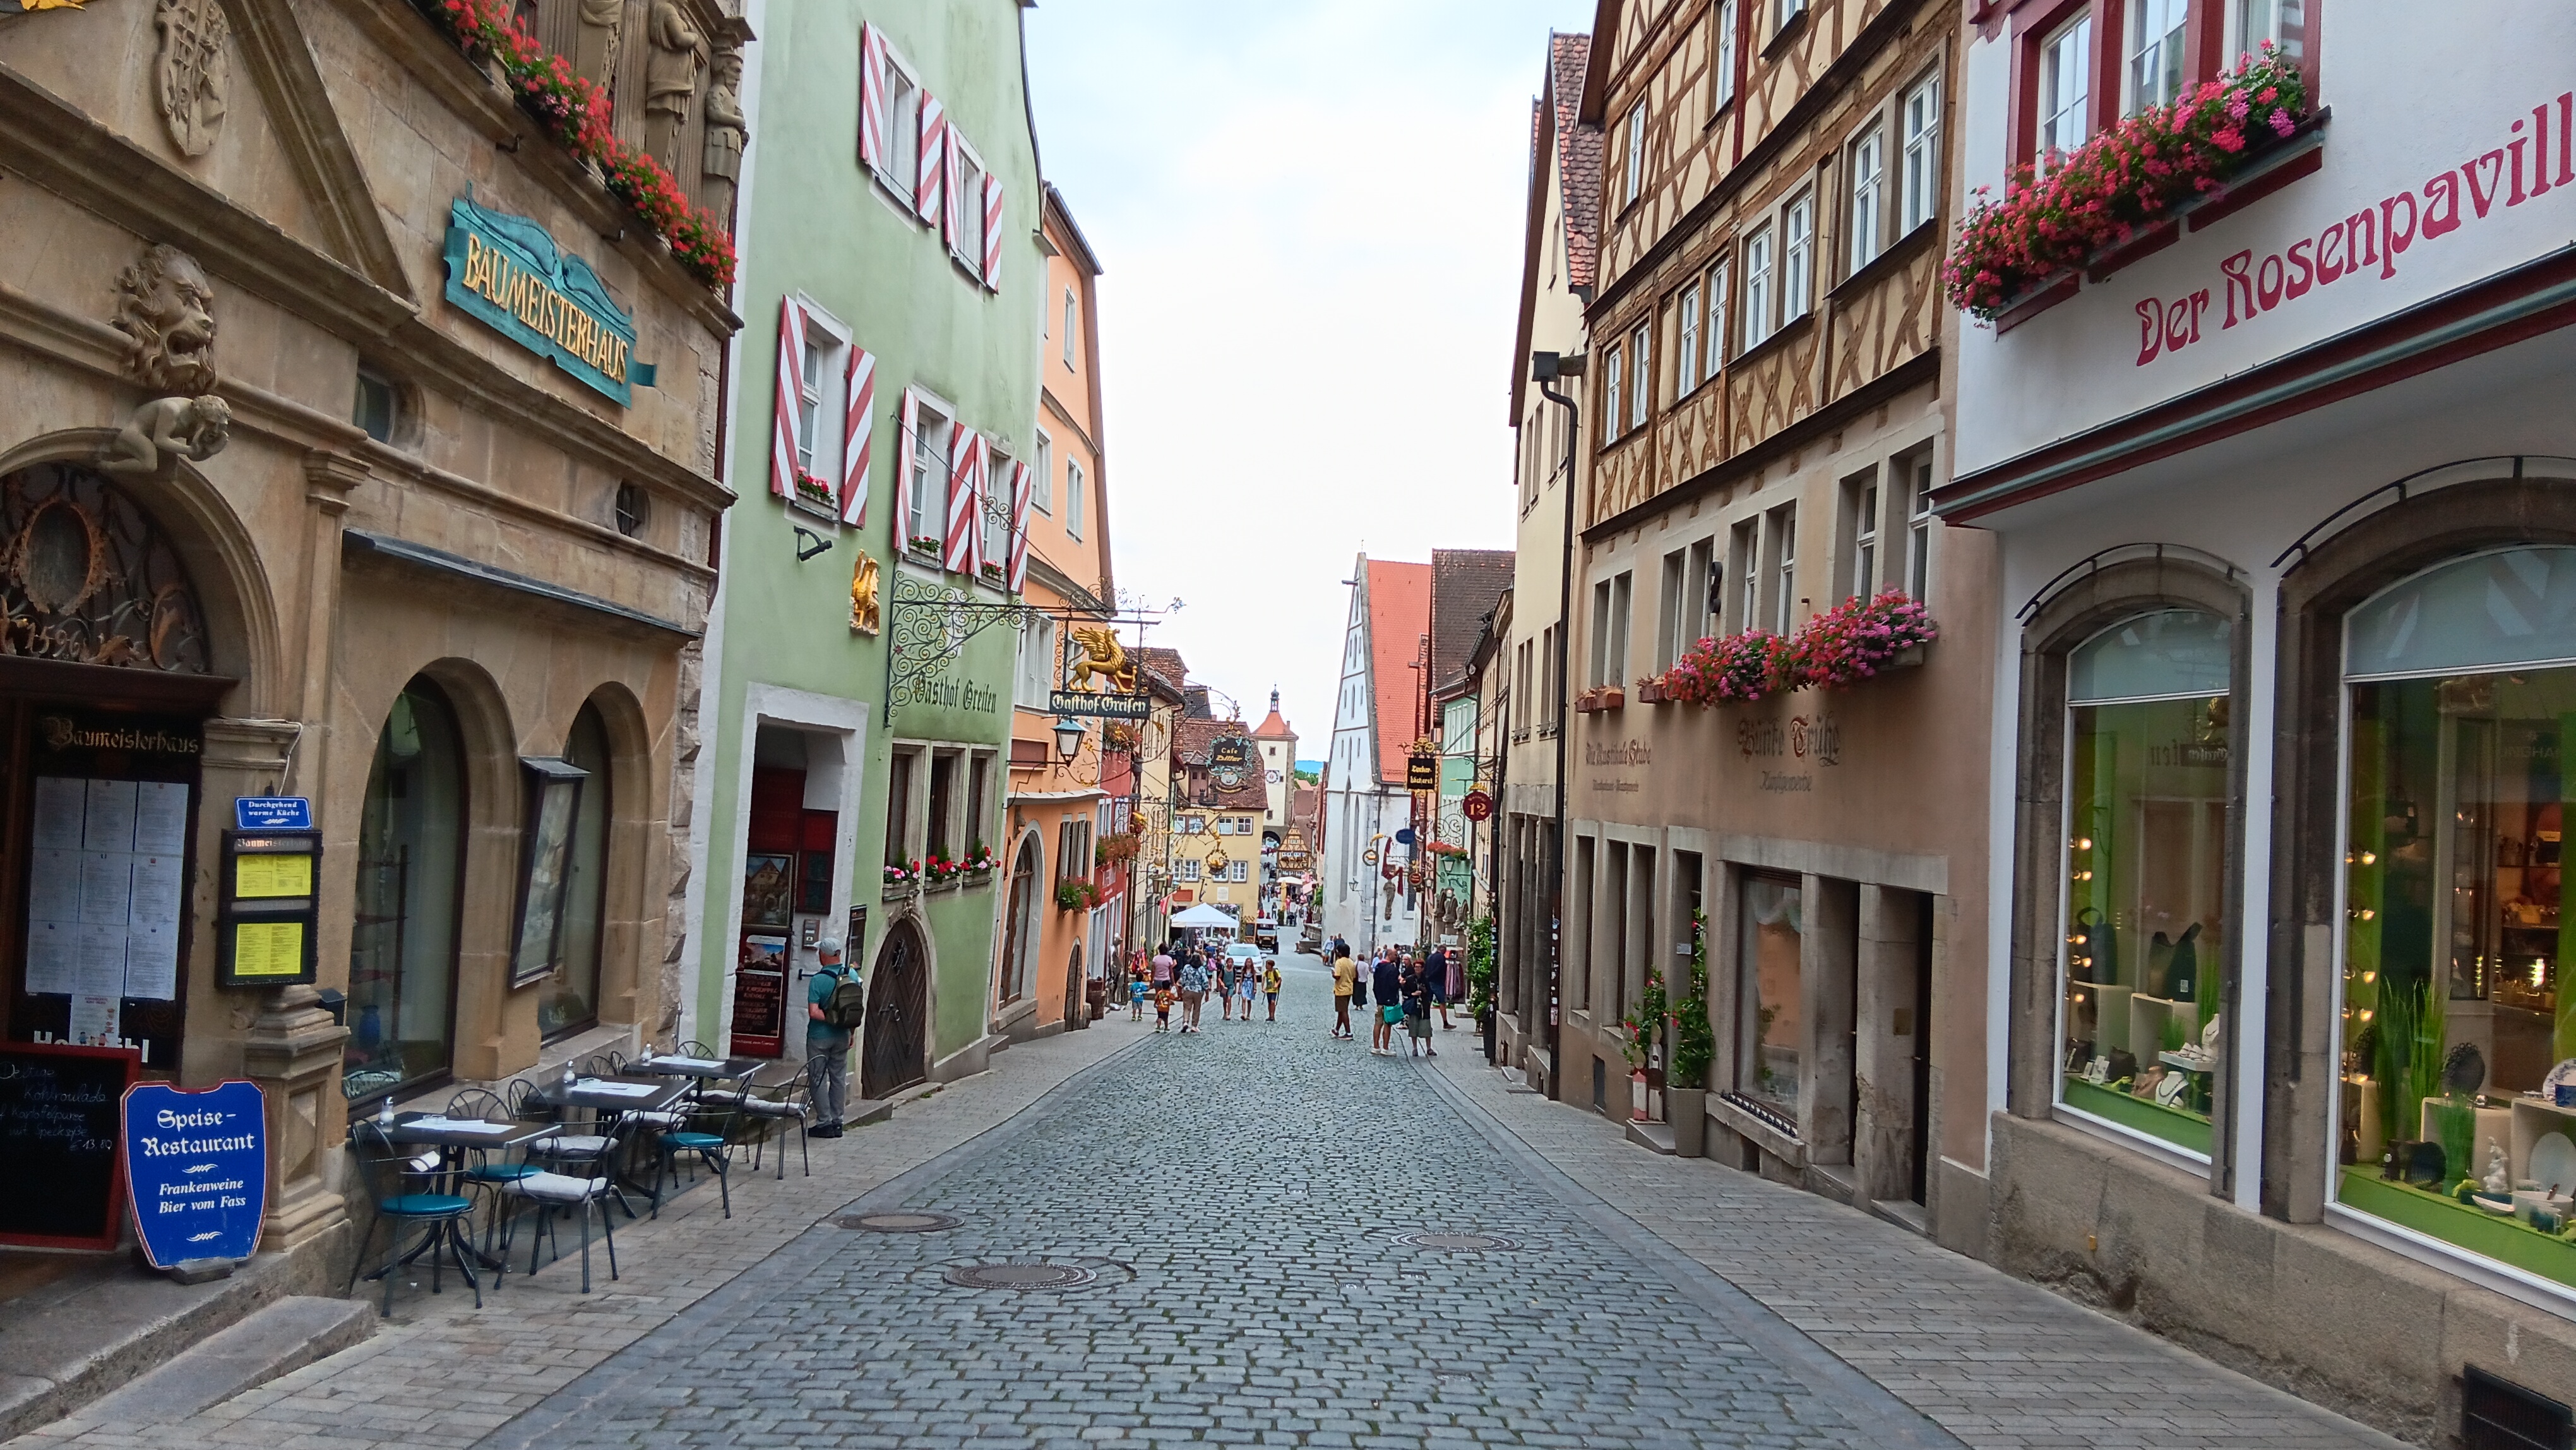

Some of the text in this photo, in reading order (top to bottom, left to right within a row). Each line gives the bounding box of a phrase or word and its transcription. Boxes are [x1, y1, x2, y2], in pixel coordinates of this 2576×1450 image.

[2136, 90, 2575, 367] Der Rosenpavill
[462, 232, 629, 384] BAUMEISTERHAUS
[915, 669, 997, 714] Gasthof Greifen
[1051, 694, 1147, 714] Gasthof Greifen
[41, 717, 199, 753] Baumeisterhaus
[1469, 803, 1486, 815] 12
[157, 1108, 236, 1132] Speise-
[141, 1133, 256, 1157] Restaurant
[158, 1178, 244, 1195] Frankenweine
[158, 1195, 246, 1214] Bier vom Fass
